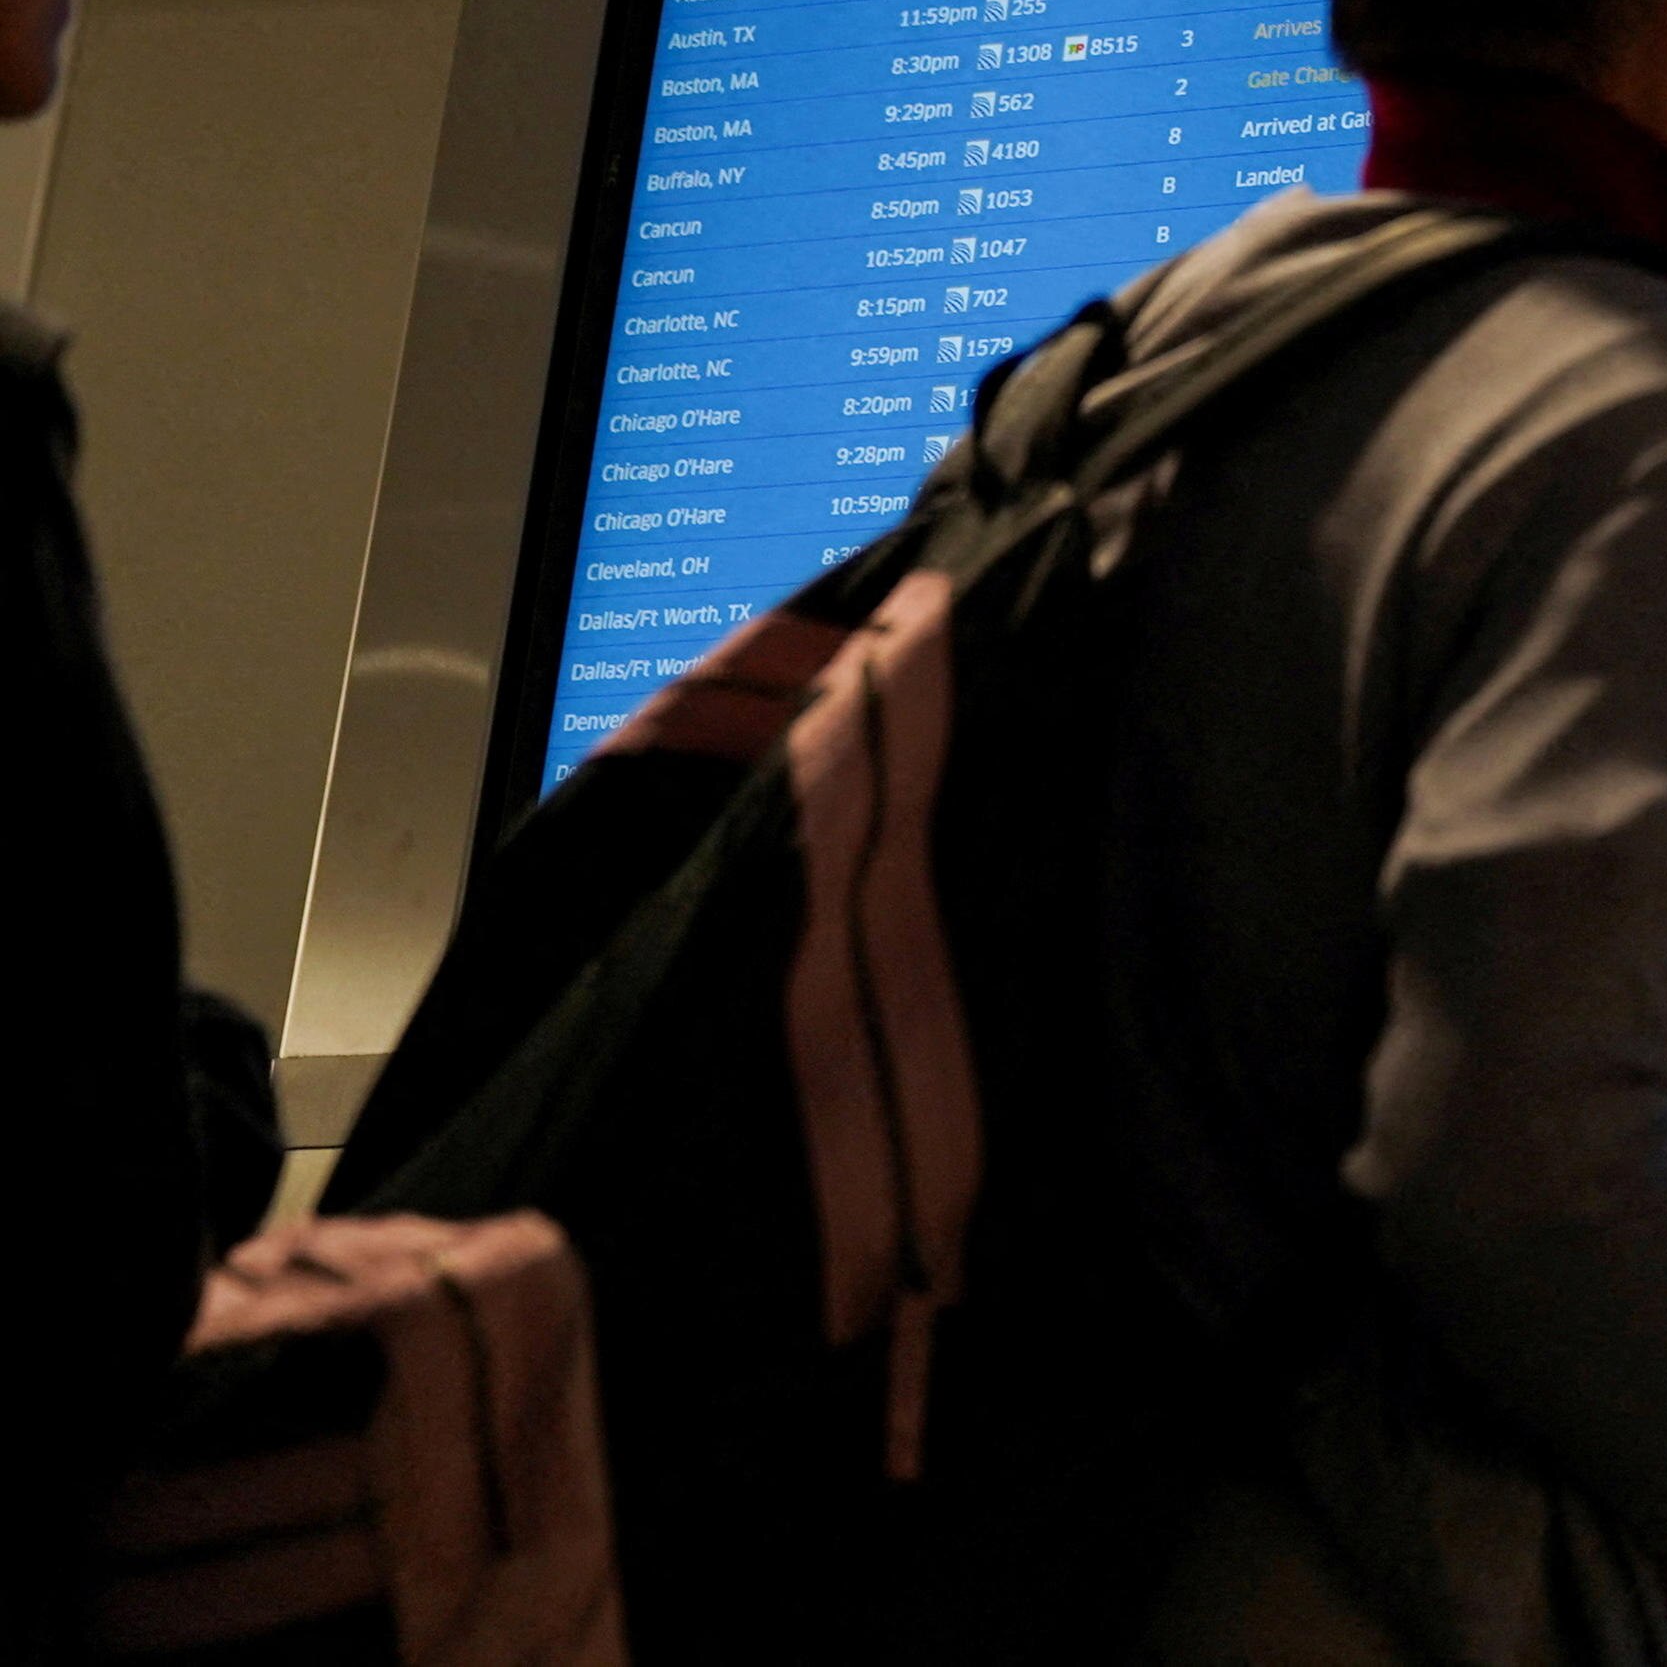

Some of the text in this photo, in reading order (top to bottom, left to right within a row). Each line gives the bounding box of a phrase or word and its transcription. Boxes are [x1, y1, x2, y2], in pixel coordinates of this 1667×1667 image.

[1155, 225, 1171, 244] B
[865, 246, 945, 269] 10:52pm
[979, 237, 1028, 259] 1047
[631, 267, 696, 288] Cancun
[586, 556, 711, 582] Cleveland, OH
